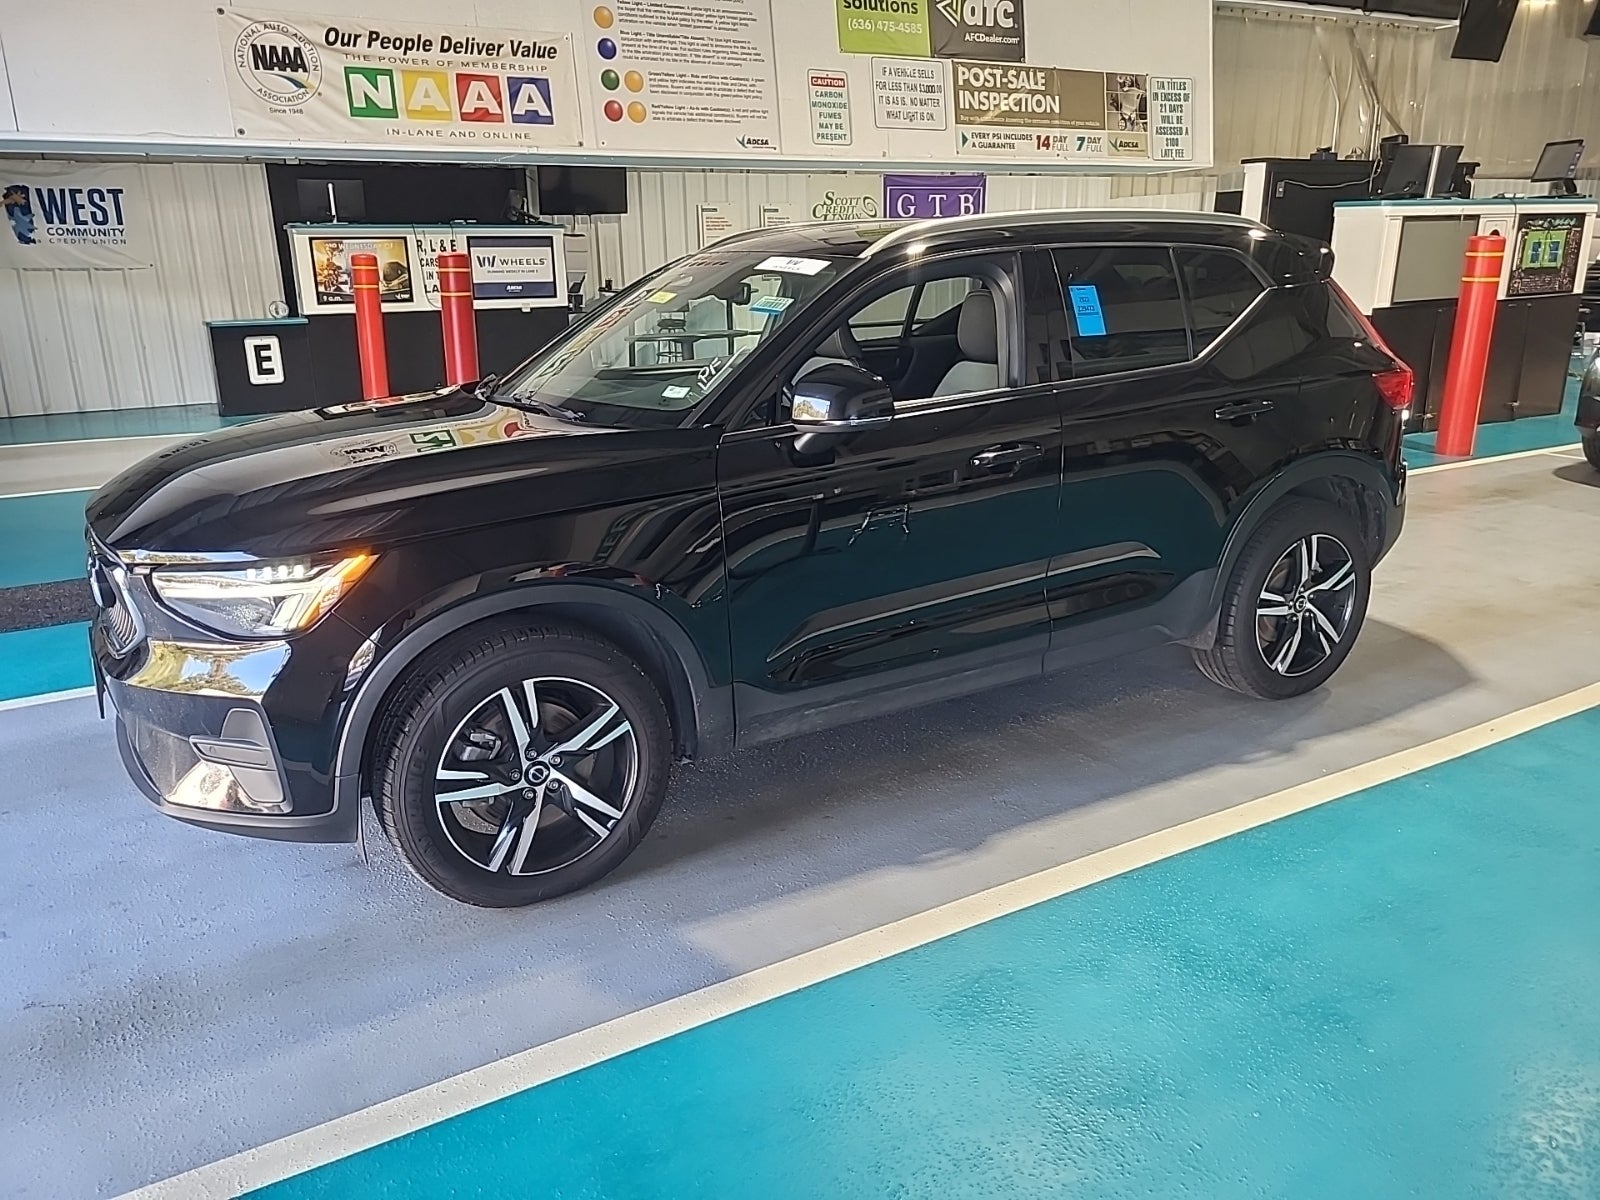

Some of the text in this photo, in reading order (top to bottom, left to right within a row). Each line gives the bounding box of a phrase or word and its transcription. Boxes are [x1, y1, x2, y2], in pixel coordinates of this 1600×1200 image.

[843, 0, 918, 14] solutions
[963, 0, 1014, 28] afc
[848, 18, 922, 34] (636) 475-4585
[238, 23, 319, 71] NATIONAL AUTO AUCTION
[325, 27, 557, 59] Our People Deliver Value
[250, 44, 308, 73] NAAA
[344, 53, 371, 61] THE
[378, 57, 429, 66] POWER
[461, 62, 547, 72] MEMBERSHIP
[917, 69, 934, 79] SELLS
[958, 66, 1045, 90] POST-SALE
[812, 78, 844, 86] CAUTION
[876, 81, 887, 90] FOR
[888, 82, 902, 91] LESS
[903, 83, 917, 92] THAN
[1167, 81, 1186, 91] TITLES
[256, 88, 309, 103] ASSOCIATION
[1153, 92, 1190, 102] IN EXCESS OF
[812, 101, 848, 109] MONOXIDE
[879, 96, 883, 104] IT
[885, 96, 890, 105] IS
[892, 96, 899, 105] AS
[910, 97, 917, 106] NO
[919, 98, 940, 107] MATTER
[959, 90, 1060, 113] INSPECTION
[1160, 103, 1183, 113] 21 DAYS
[886, 110, 901, 120] WHAT
[903, 111, 918, 120] LIGHT
[920, 112, 925, 121] IS
[1161, 115, 1183, 124] WILL BE
[387, 128, 531, 140] IN-LANE AND ONLINE
[1155, 126, 1188, 136] ASSESSED A
[978, 142, 1015, 150] GUARANTEE
[1036, 135, 1050, 150] 14
[1052, 143, 1069, 151] FULL
[1076, 136, 1085, 151] 7
[1165, 137, 1179, 147] $100
[1086, 144, 1103, 152] FULL
[1161, 149, 1184, 158] LATE FEE
[35, 187, 124, 226] WEST
[46, 227, 125, 237] COMMUNITY
[430, 240, 435, 252] L
[440, 240, 446, 252] &
[450, 240, 457, 252] E
[426, 271, 434, 280] IN
[254, 344, 274, 376] E
